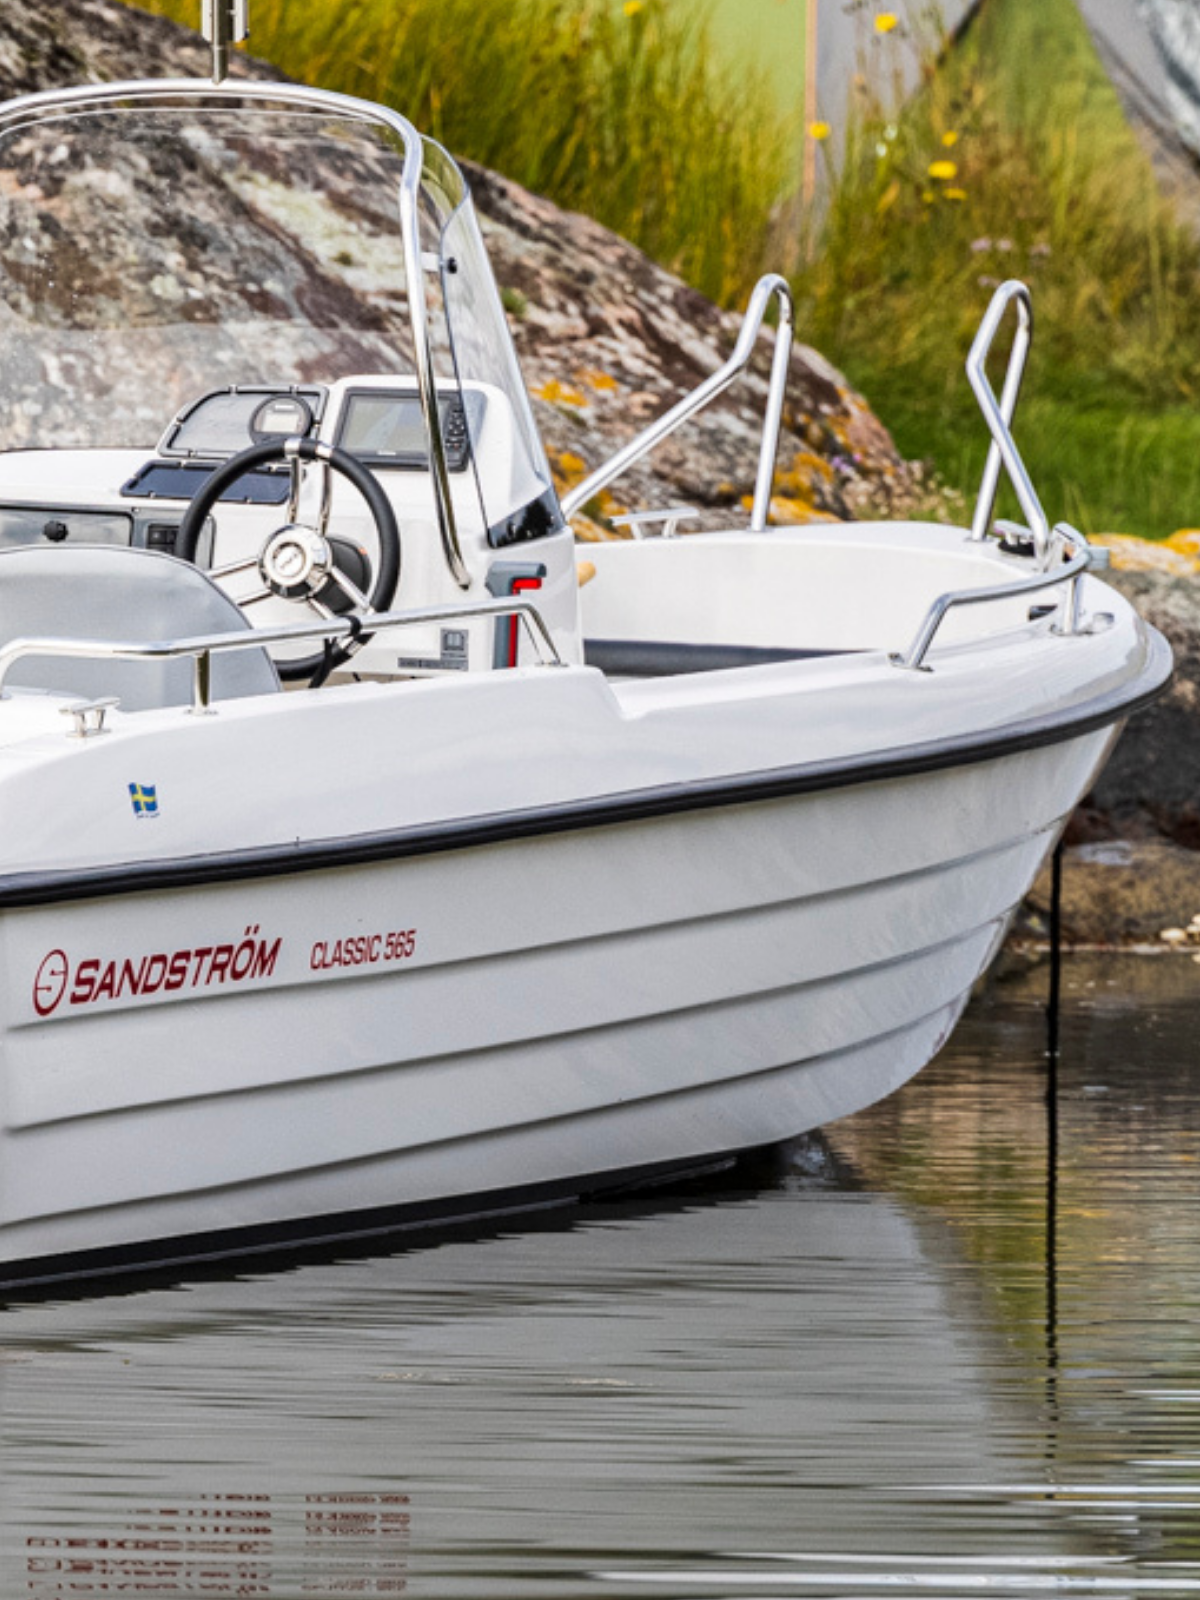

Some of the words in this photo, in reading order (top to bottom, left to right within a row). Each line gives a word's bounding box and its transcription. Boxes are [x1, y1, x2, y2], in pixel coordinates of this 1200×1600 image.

[69, 923, 283, 1005] SANDSTRÖM
[309, 934, 383, 970] CLASSIC
[382, 928, 417, 960] 565
